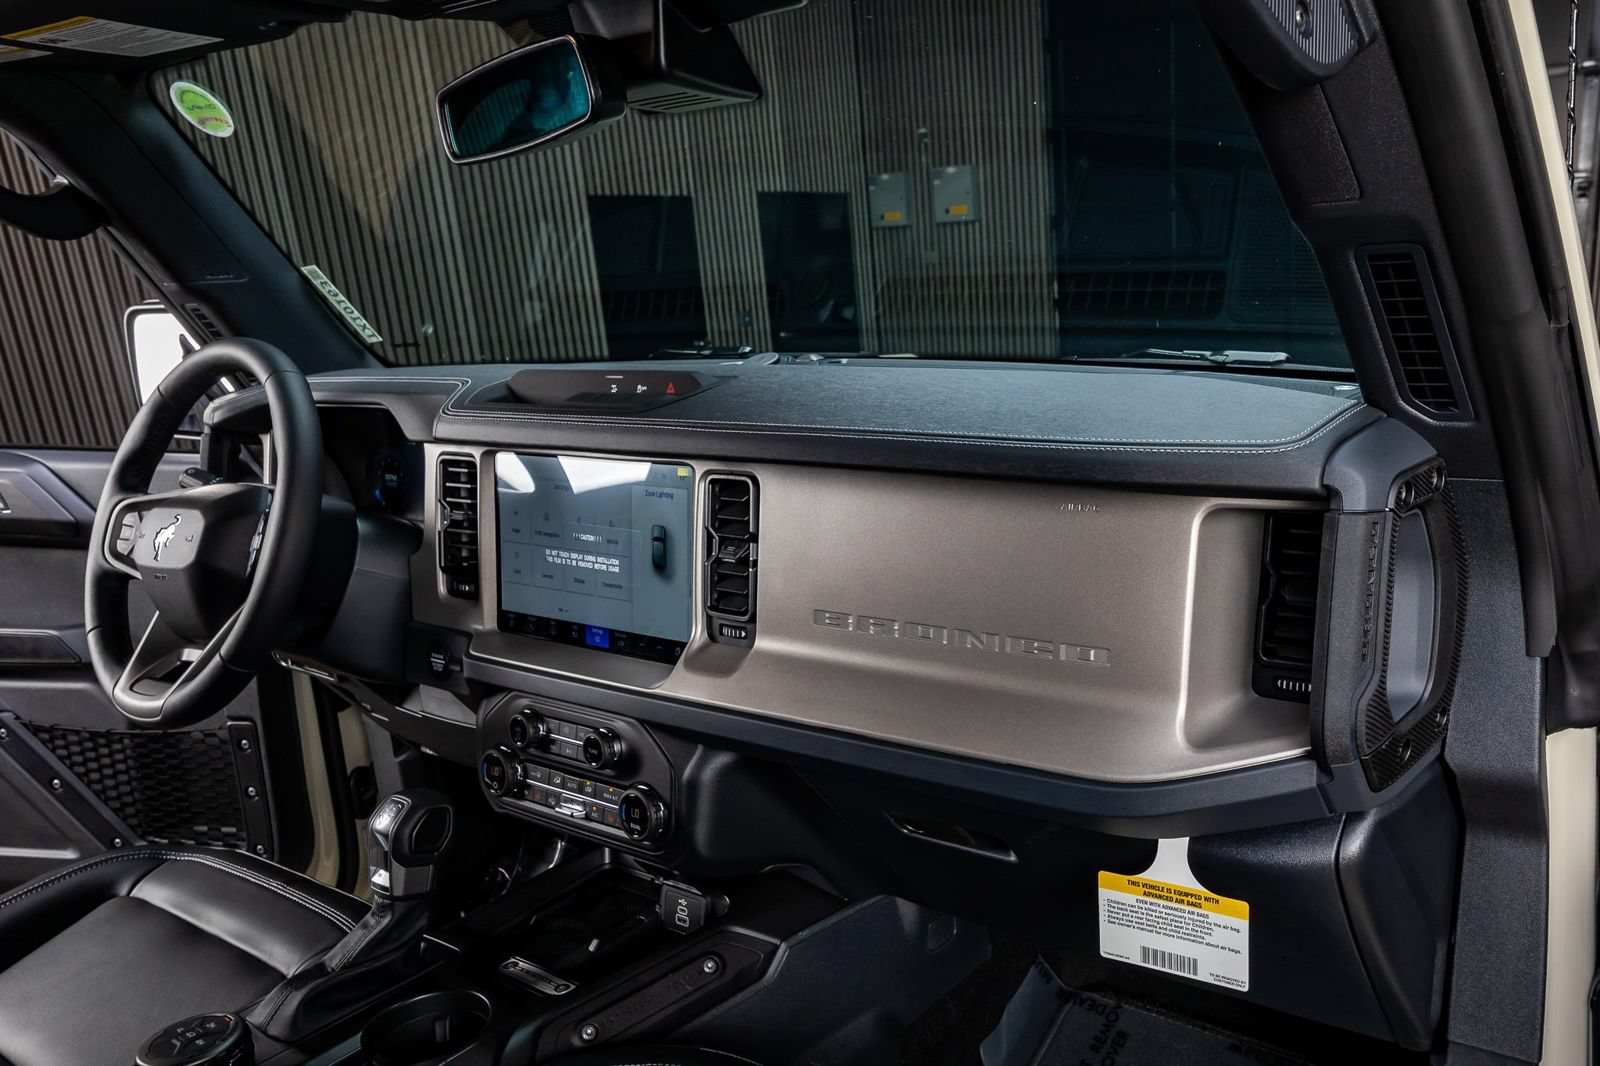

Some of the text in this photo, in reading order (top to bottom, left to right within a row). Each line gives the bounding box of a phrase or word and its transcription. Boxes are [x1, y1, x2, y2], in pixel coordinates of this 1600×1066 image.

[570, 552, 583, 560] DISPLAY
[584, 554, 596, 562] DURING
[597, 556, 620, 566] INSTALLATION
[577, 560, 593, 569] REMOVED
[594, 563, 607, 571] BEFORE
[608, 565, 620, 573] USAGE
[813, 608, 1111, 668] BRONCO
[1127, 879, 1140, 888] THIS
[1142, 882, 1165, 893] VEHICLE
[1173, 889, 1202, 901] EQUIPPED
[1203, 895, 1220, 905] WITH
[1142, 890, 1174, 903] ADVANCED
[1186, 899, 1202, 909] BAGS
[1106, 898, 1127, 907] Children
[1144, 906, 1157, 914] killed
[1164, 911, 1187, 921] seriously
[1188, 916, 1205, 925] injured
[1230, 925, 1241, 934] bag.
[1136, 898, 1148, 906] EVEN
[1162, 903, 1186, 914] ADVANCED
[1196, 911, 1209, 919] BAGS
[1107, 914, 1124, 922] Always
[1181, 931, 1206, 940] restraints.
[1145, 917, 1160, 925] facing
[1169, 916, 1183, 924] place
[1192, 923, 1214, 932] Children.
[1175, 935, 1204, 945] information
[1205, 941, 1219, 949] about
[1227, 946, 1242, 955] bags.
